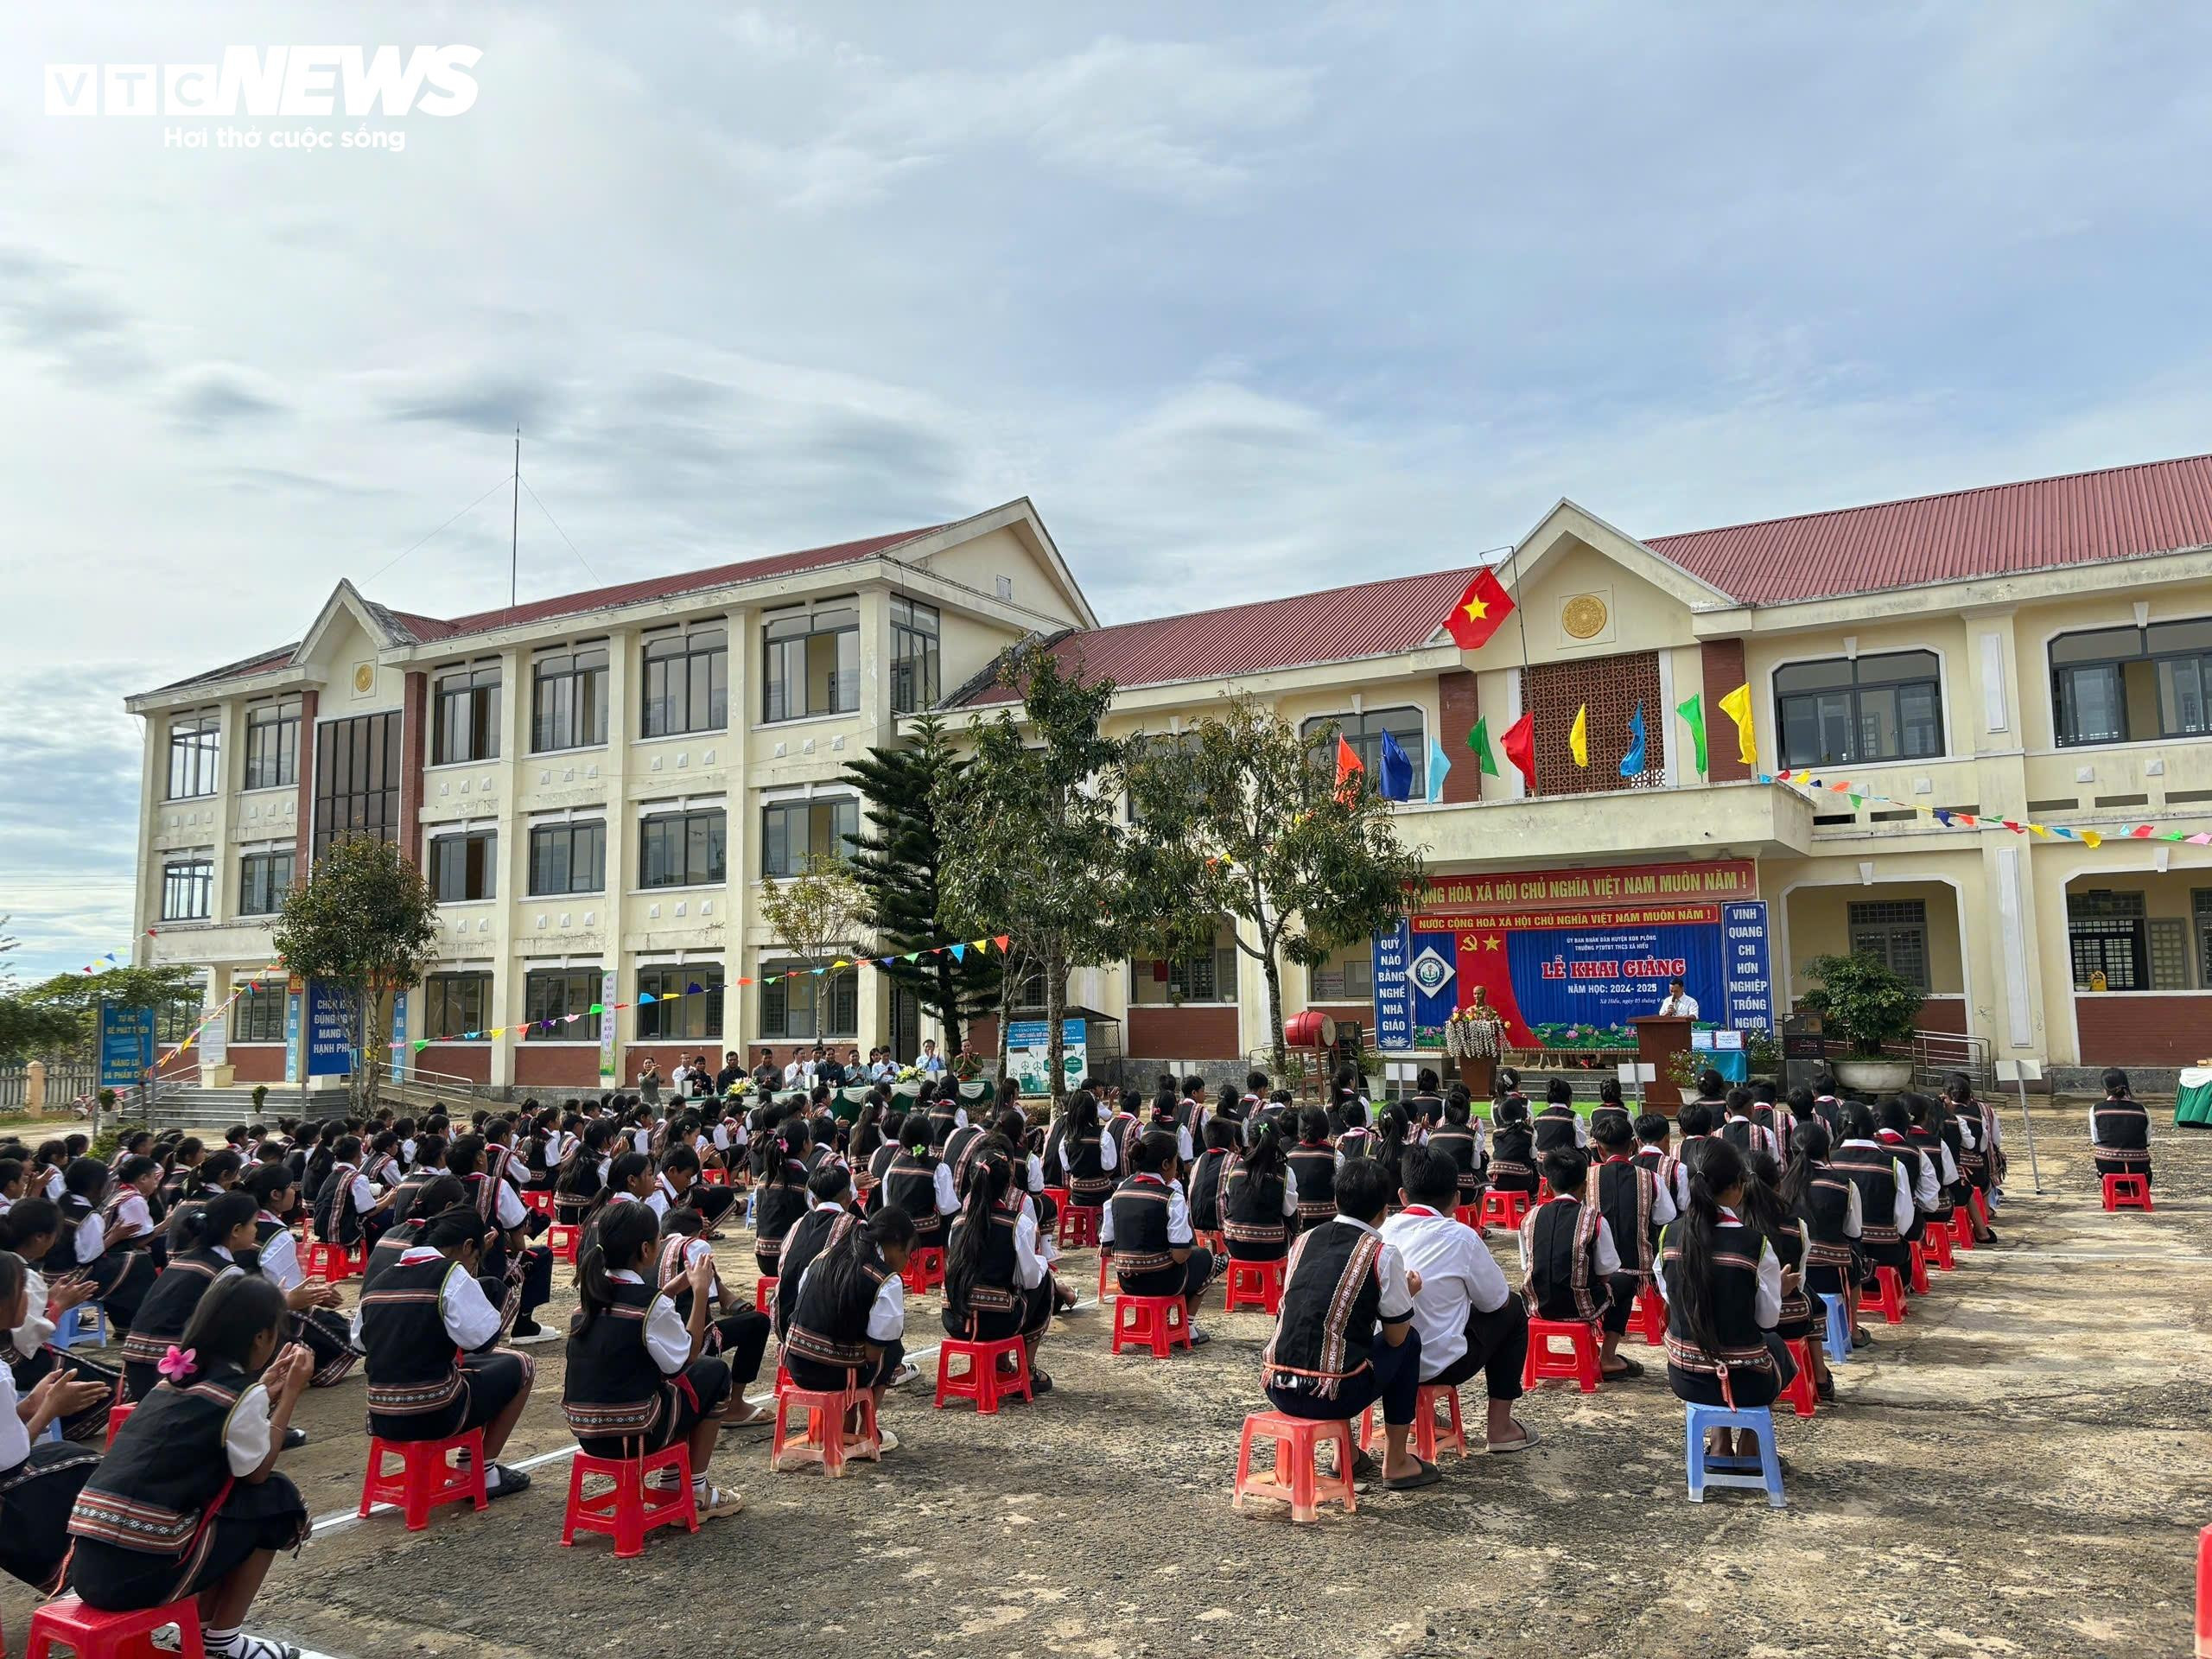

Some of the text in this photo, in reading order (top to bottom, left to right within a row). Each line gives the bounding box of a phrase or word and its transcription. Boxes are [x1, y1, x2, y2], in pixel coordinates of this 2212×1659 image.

[1449, 881, 1472, 903] HÒA
[1476, 881, 1493, 901] XÃ
[1497, 880, 1516, 904] HỘI
[1521, 876, 1546, 899] CHỦ
[1549, 876, 1590, 898] NGHĨA
[1592, 874, 1621, 899] VIỆT
[1624, 875, 1655, 894] NAM
[1659, 871, 1700, 893] MUÔN
[1704, 868, 1738, 891] NĂM
[1419, 918, 1445, 929] NƯỚC
[1447, 917, 1473, 930] CỘNG
[1498, 916, 1512, 927] XÃ
[1515, 916, 1531, 928] HỘI
[1534, 913, 1554, 925] CHỦ
[1557, 913, 1588, 925] NGHĨA
[1591, 912, 1612, 925] VIỆT
[1615, 913, 1640, 923] NAM
[1643, 910, 1675, 921] MUÔN
[1678, 908, 1703, 919] NĂM
[1732, 909, 1757, 920] VINH
[1729, 926, 1763, 938] QUANG
[1381, 938, 1400, 950] QUÝ
[1738, 944, 1756, 956] CHI
[1381, 954, 1401, 965] NÀO
[1541, 955, 1686, 979] LỄ KHAI GIẢNG
[1738, 962, 1758, 974] HƠN
[1568, 983, 1586, 994] NĂM
[1588, 985, 1608, 995] HỌC:
[1637, 983, 1657, 993] 2025
[1731, 978, 1767, 994] NGHIỆP
[1383, 1004, 1403, 1014] NHÀ
[314, 1012, 335, 1024] ĐÚNG
[1734, 1014, 1766, 1028] NGƯỜI
[1382, 1019, 1406, 1031] GIÁO
[318, 1028, 341, 1039] MANG
[314, 1043, 334, 1056] HẠNH
